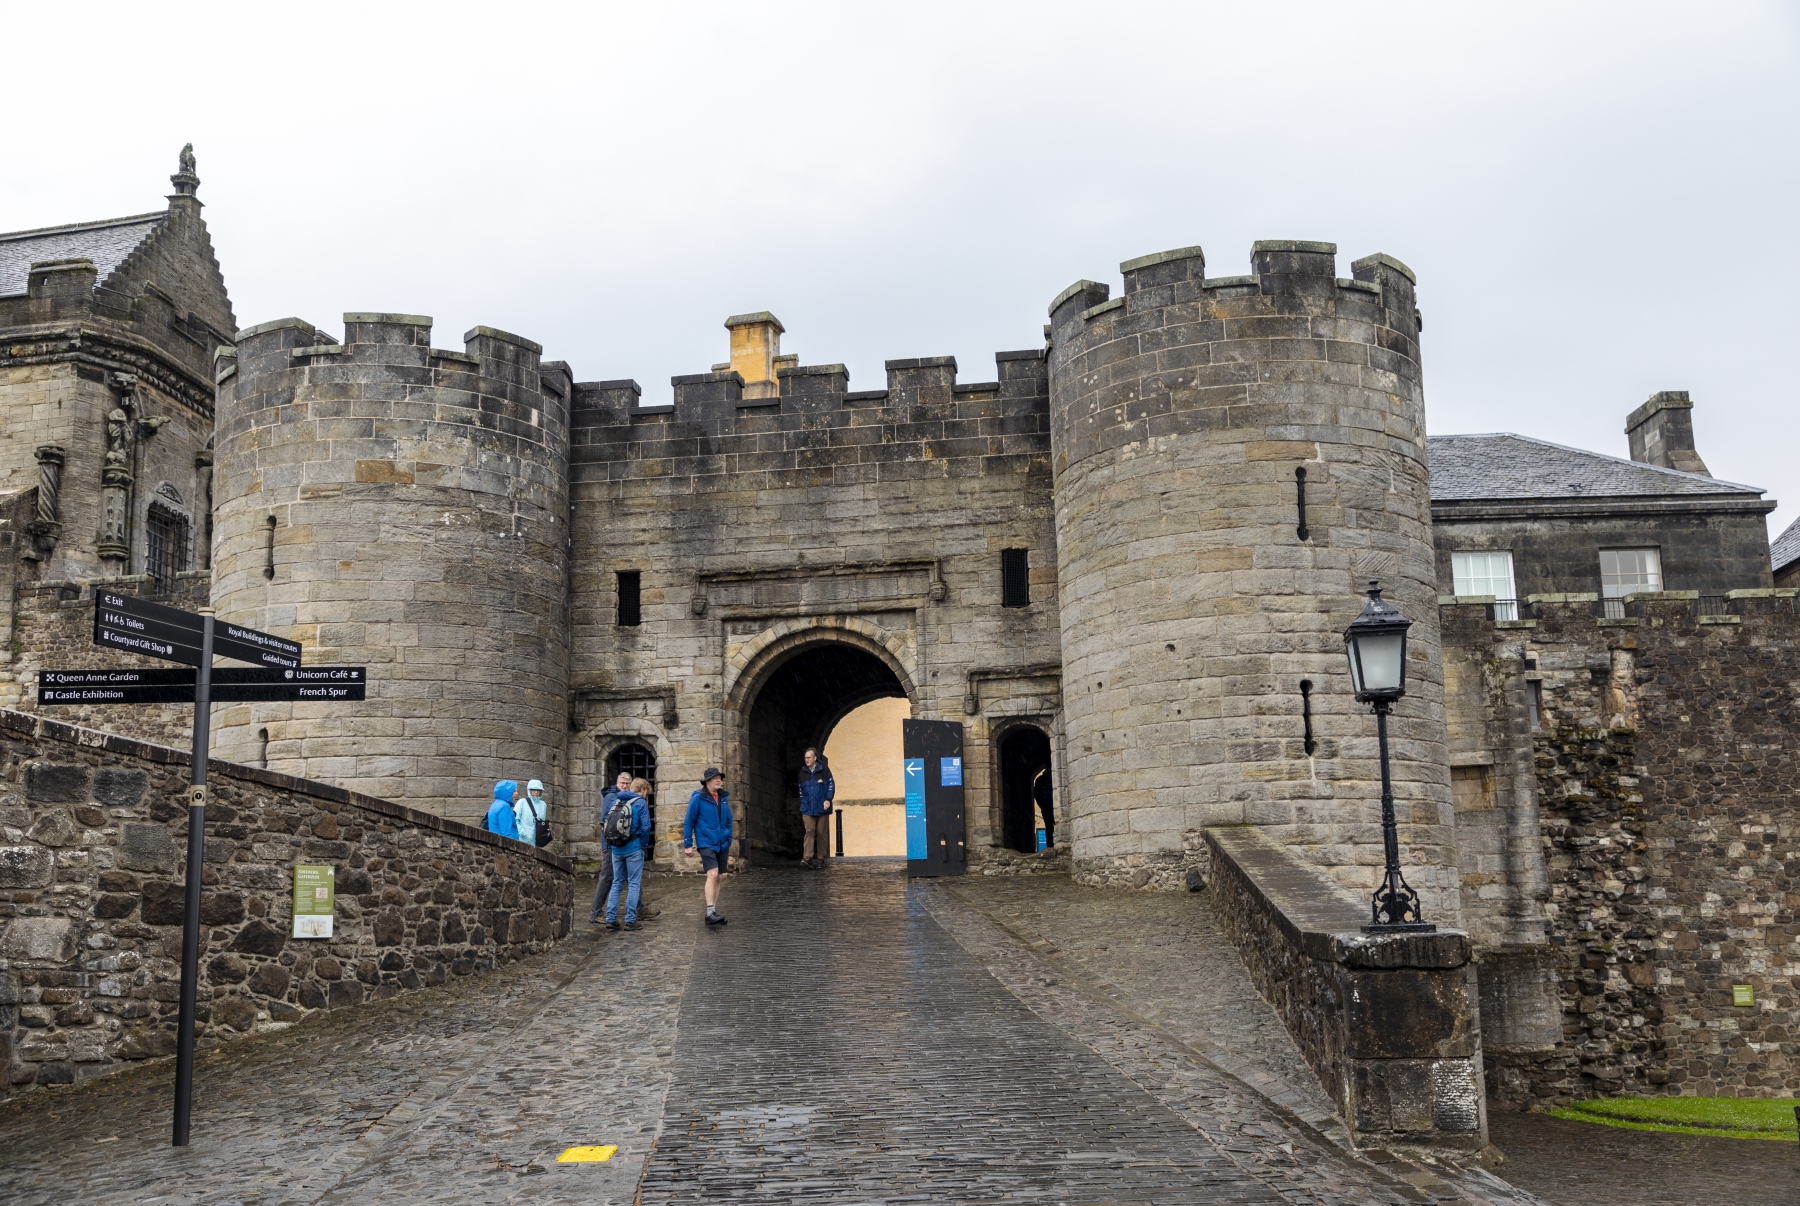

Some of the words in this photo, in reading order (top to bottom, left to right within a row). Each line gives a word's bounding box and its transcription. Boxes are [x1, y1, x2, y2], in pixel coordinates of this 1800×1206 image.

[126, 618, 144, 630] Toilets
[110, 632, 139, 646] Courtyard
[140, 640, 150, 650] Gift
[151, 642, 166, 654] Shop
[228, 626, 242, 638] Royal
[242, 631, 263, 644] Buildings
[269, 639, 283, 648] visitor
[283, 644, 298, 652] routes
[262, 653, 279, 664] Guided
[280, 658, 292, 666] tours
[56, 674, 84, 683] Queen
[330, 670, 348, 678] Café
[82, 690, 123, 698] Exhibition
[300, 688, 326, 696] French
[328, 688, 348, 697] Spur
